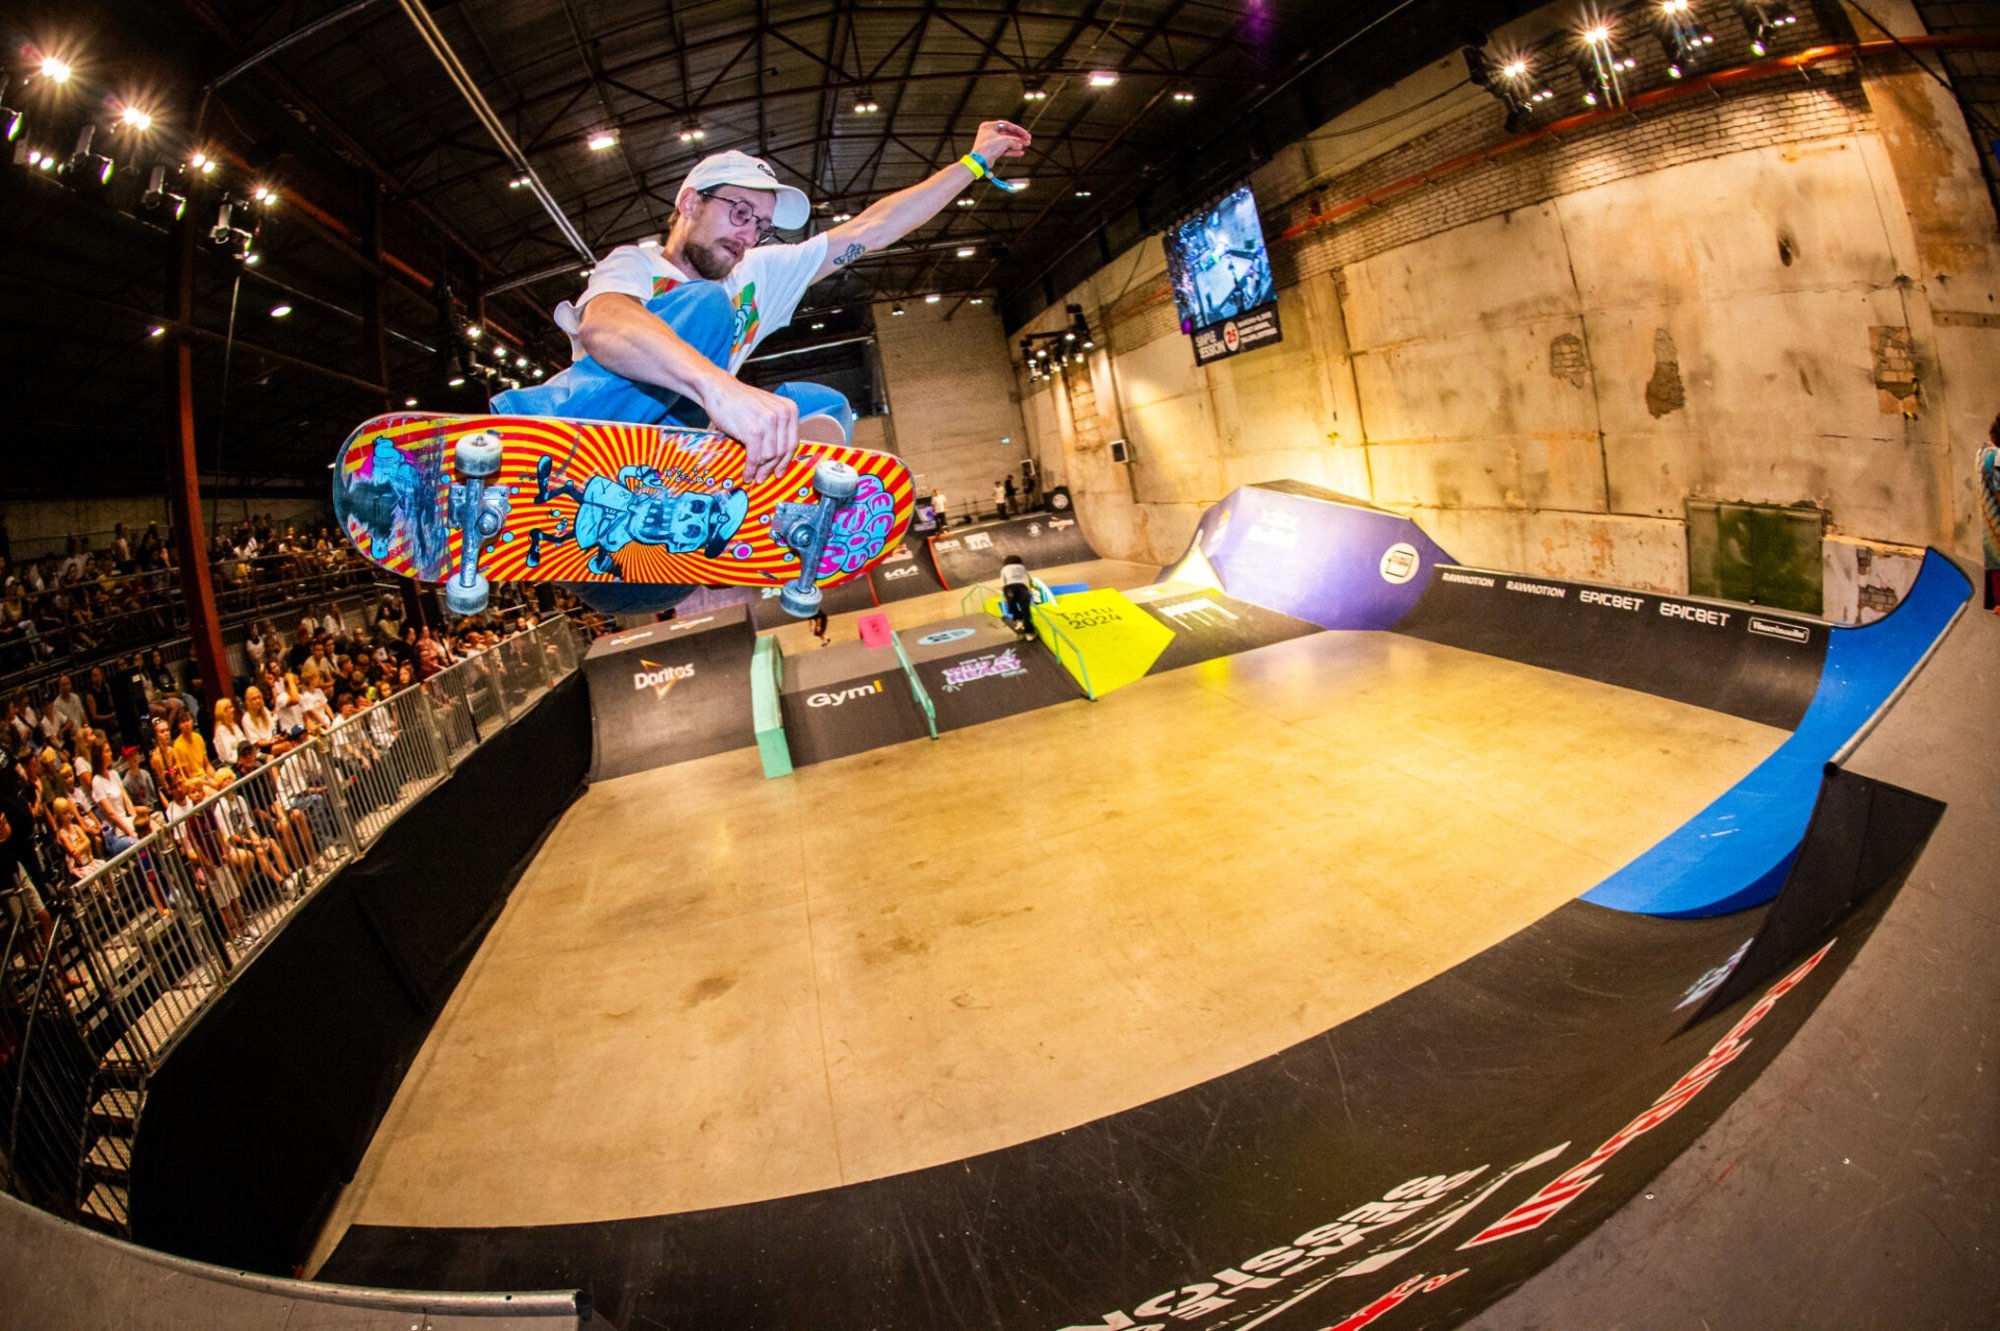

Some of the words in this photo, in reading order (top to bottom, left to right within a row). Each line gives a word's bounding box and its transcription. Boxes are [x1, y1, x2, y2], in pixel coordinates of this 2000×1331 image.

[1506, 580, 1566, 598] RAWMOTION
[1579, 590, 1644, 611] EPICBET
[1068, 614, 1123, 630] 2024
[1659, 602, 1731, 627] EPICBET
[634, 663, 696, 690] Doritos
[1651, 937, 1838, 1107] Red
[1455, 1070, 1721, 1251] Bull
